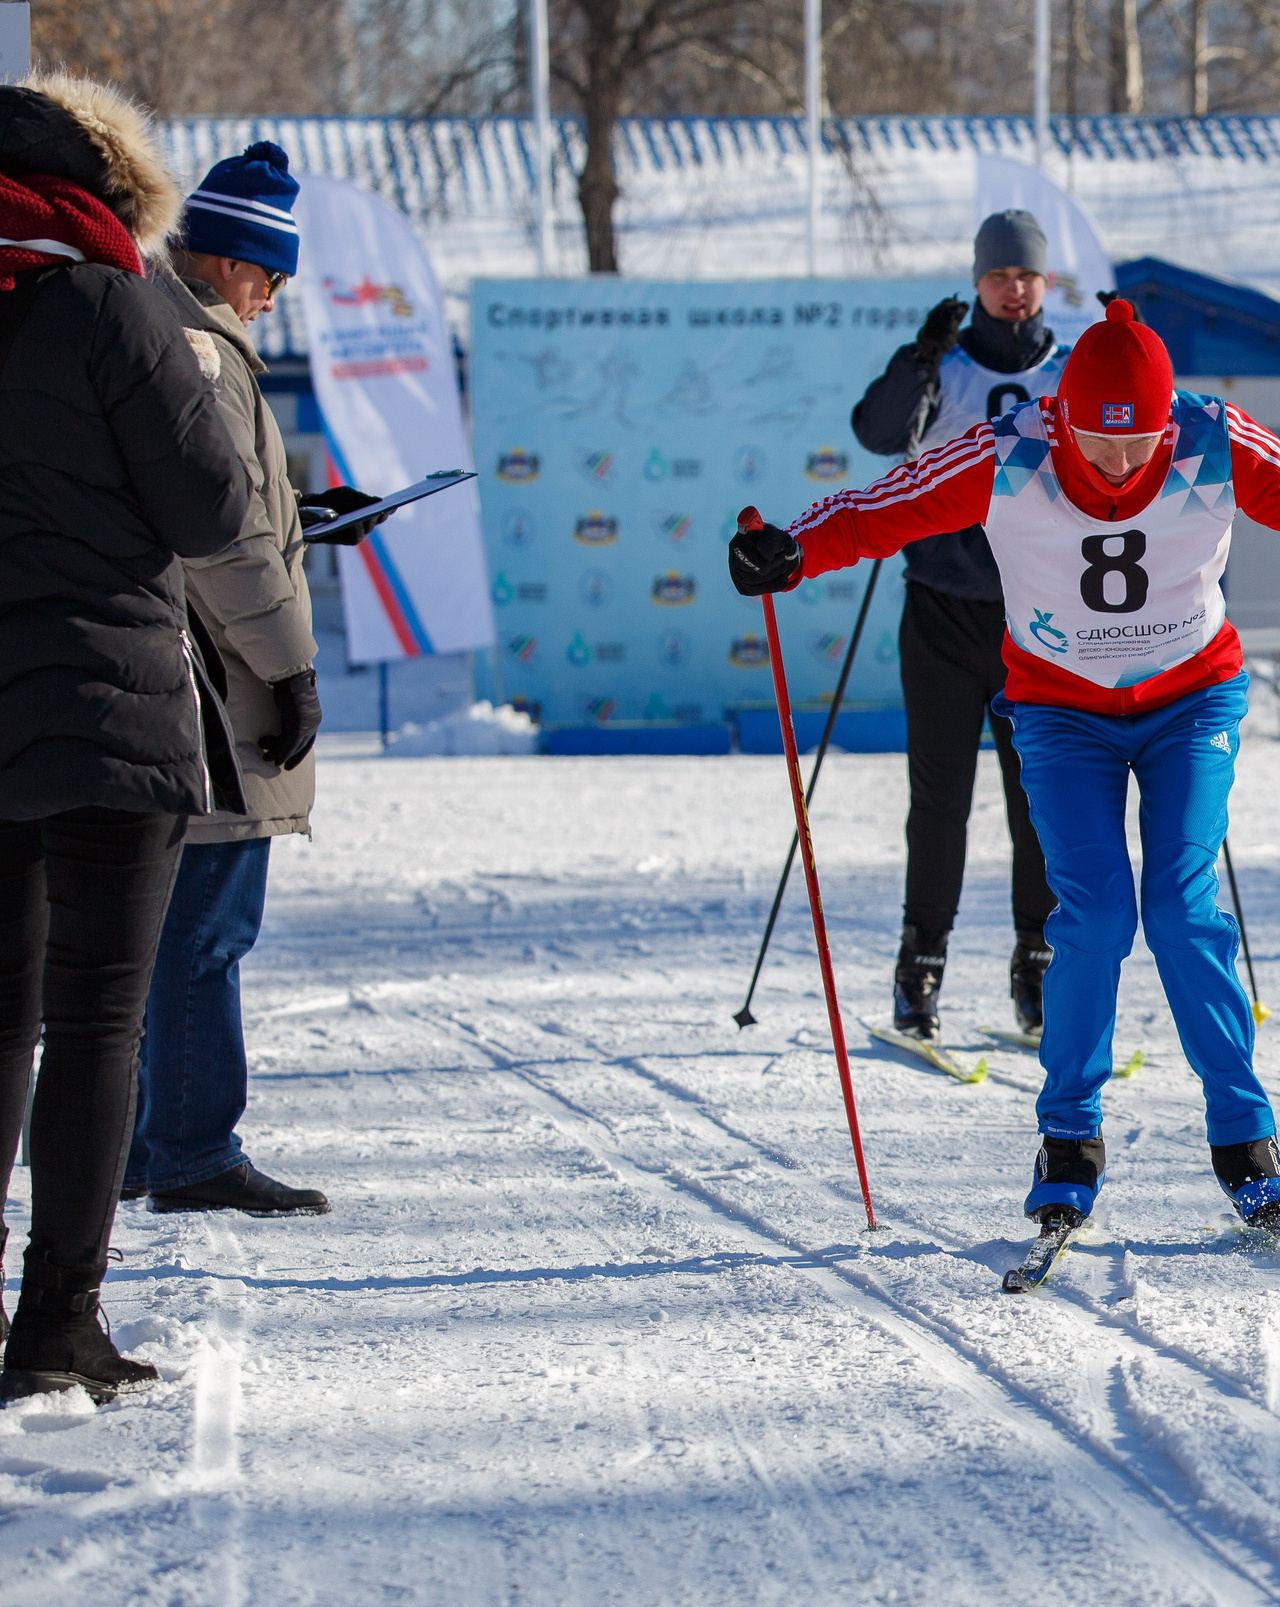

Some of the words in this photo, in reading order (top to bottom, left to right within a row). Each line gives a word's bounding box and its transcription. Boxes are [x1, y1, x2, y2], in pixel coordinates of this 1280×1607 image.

[487, 303, 670, 333] Спортивная
[686, 306, 786, 329] школа
[795, 302, 842, 328] №2
[852, 306, 929, 331] горо
[1080, 529, 1149, 613] 8
[1076, 623, 1178, 641] СДЮСШОР
[1182, 609, 1207, 628] №2
[1047, 1126, 1091, 1136] SPINE
